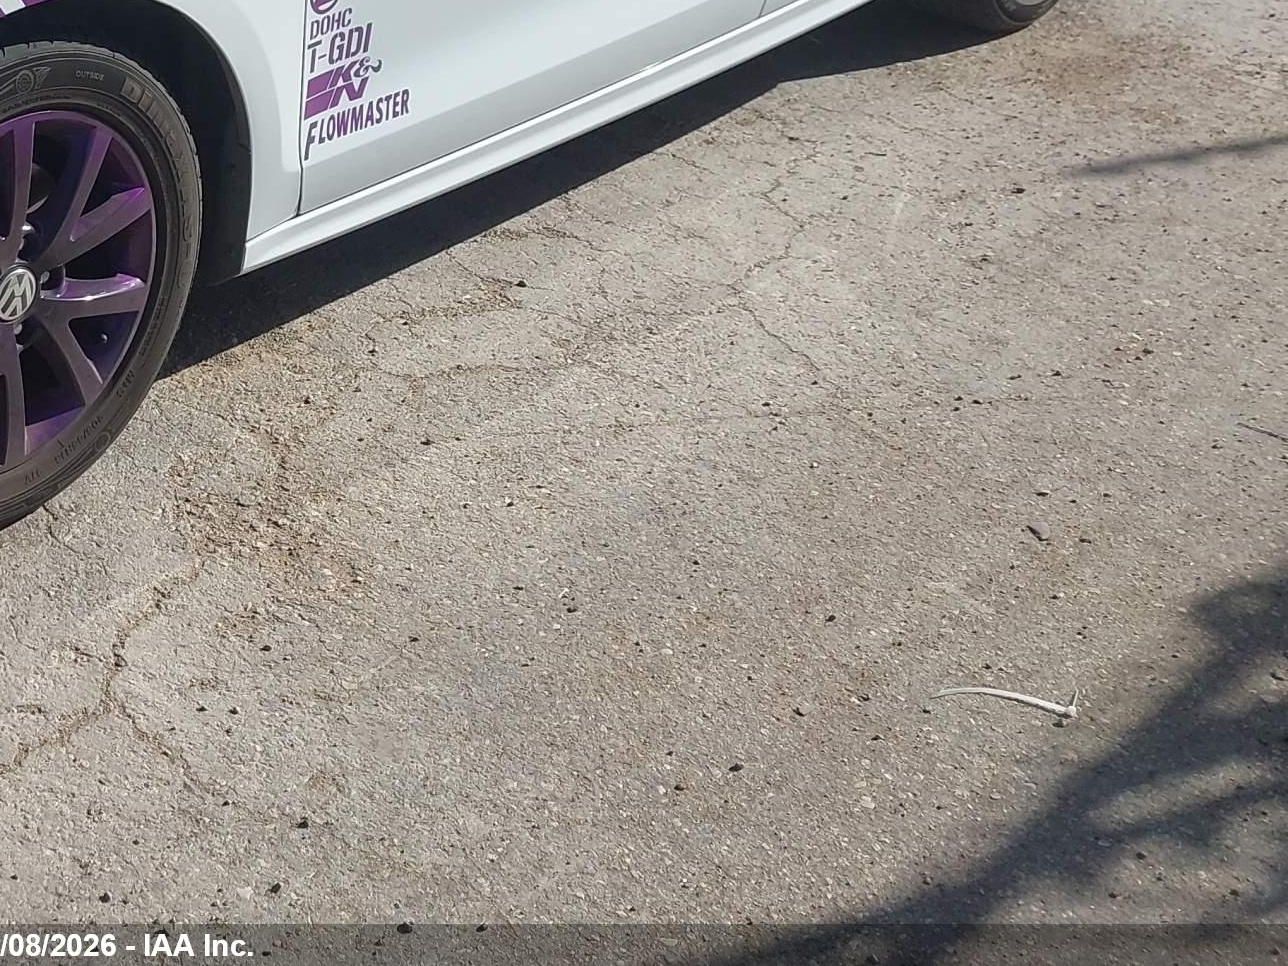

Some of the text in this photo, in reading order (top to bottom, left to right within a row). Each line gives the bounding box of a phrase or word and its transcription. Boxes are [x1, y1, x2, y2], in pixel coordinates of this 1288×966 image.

[307, 22, 373, 75] T-GDI
[309, 8, 353, 40] DOHC
[303, 89, 410, 161] FLOWMASTER
